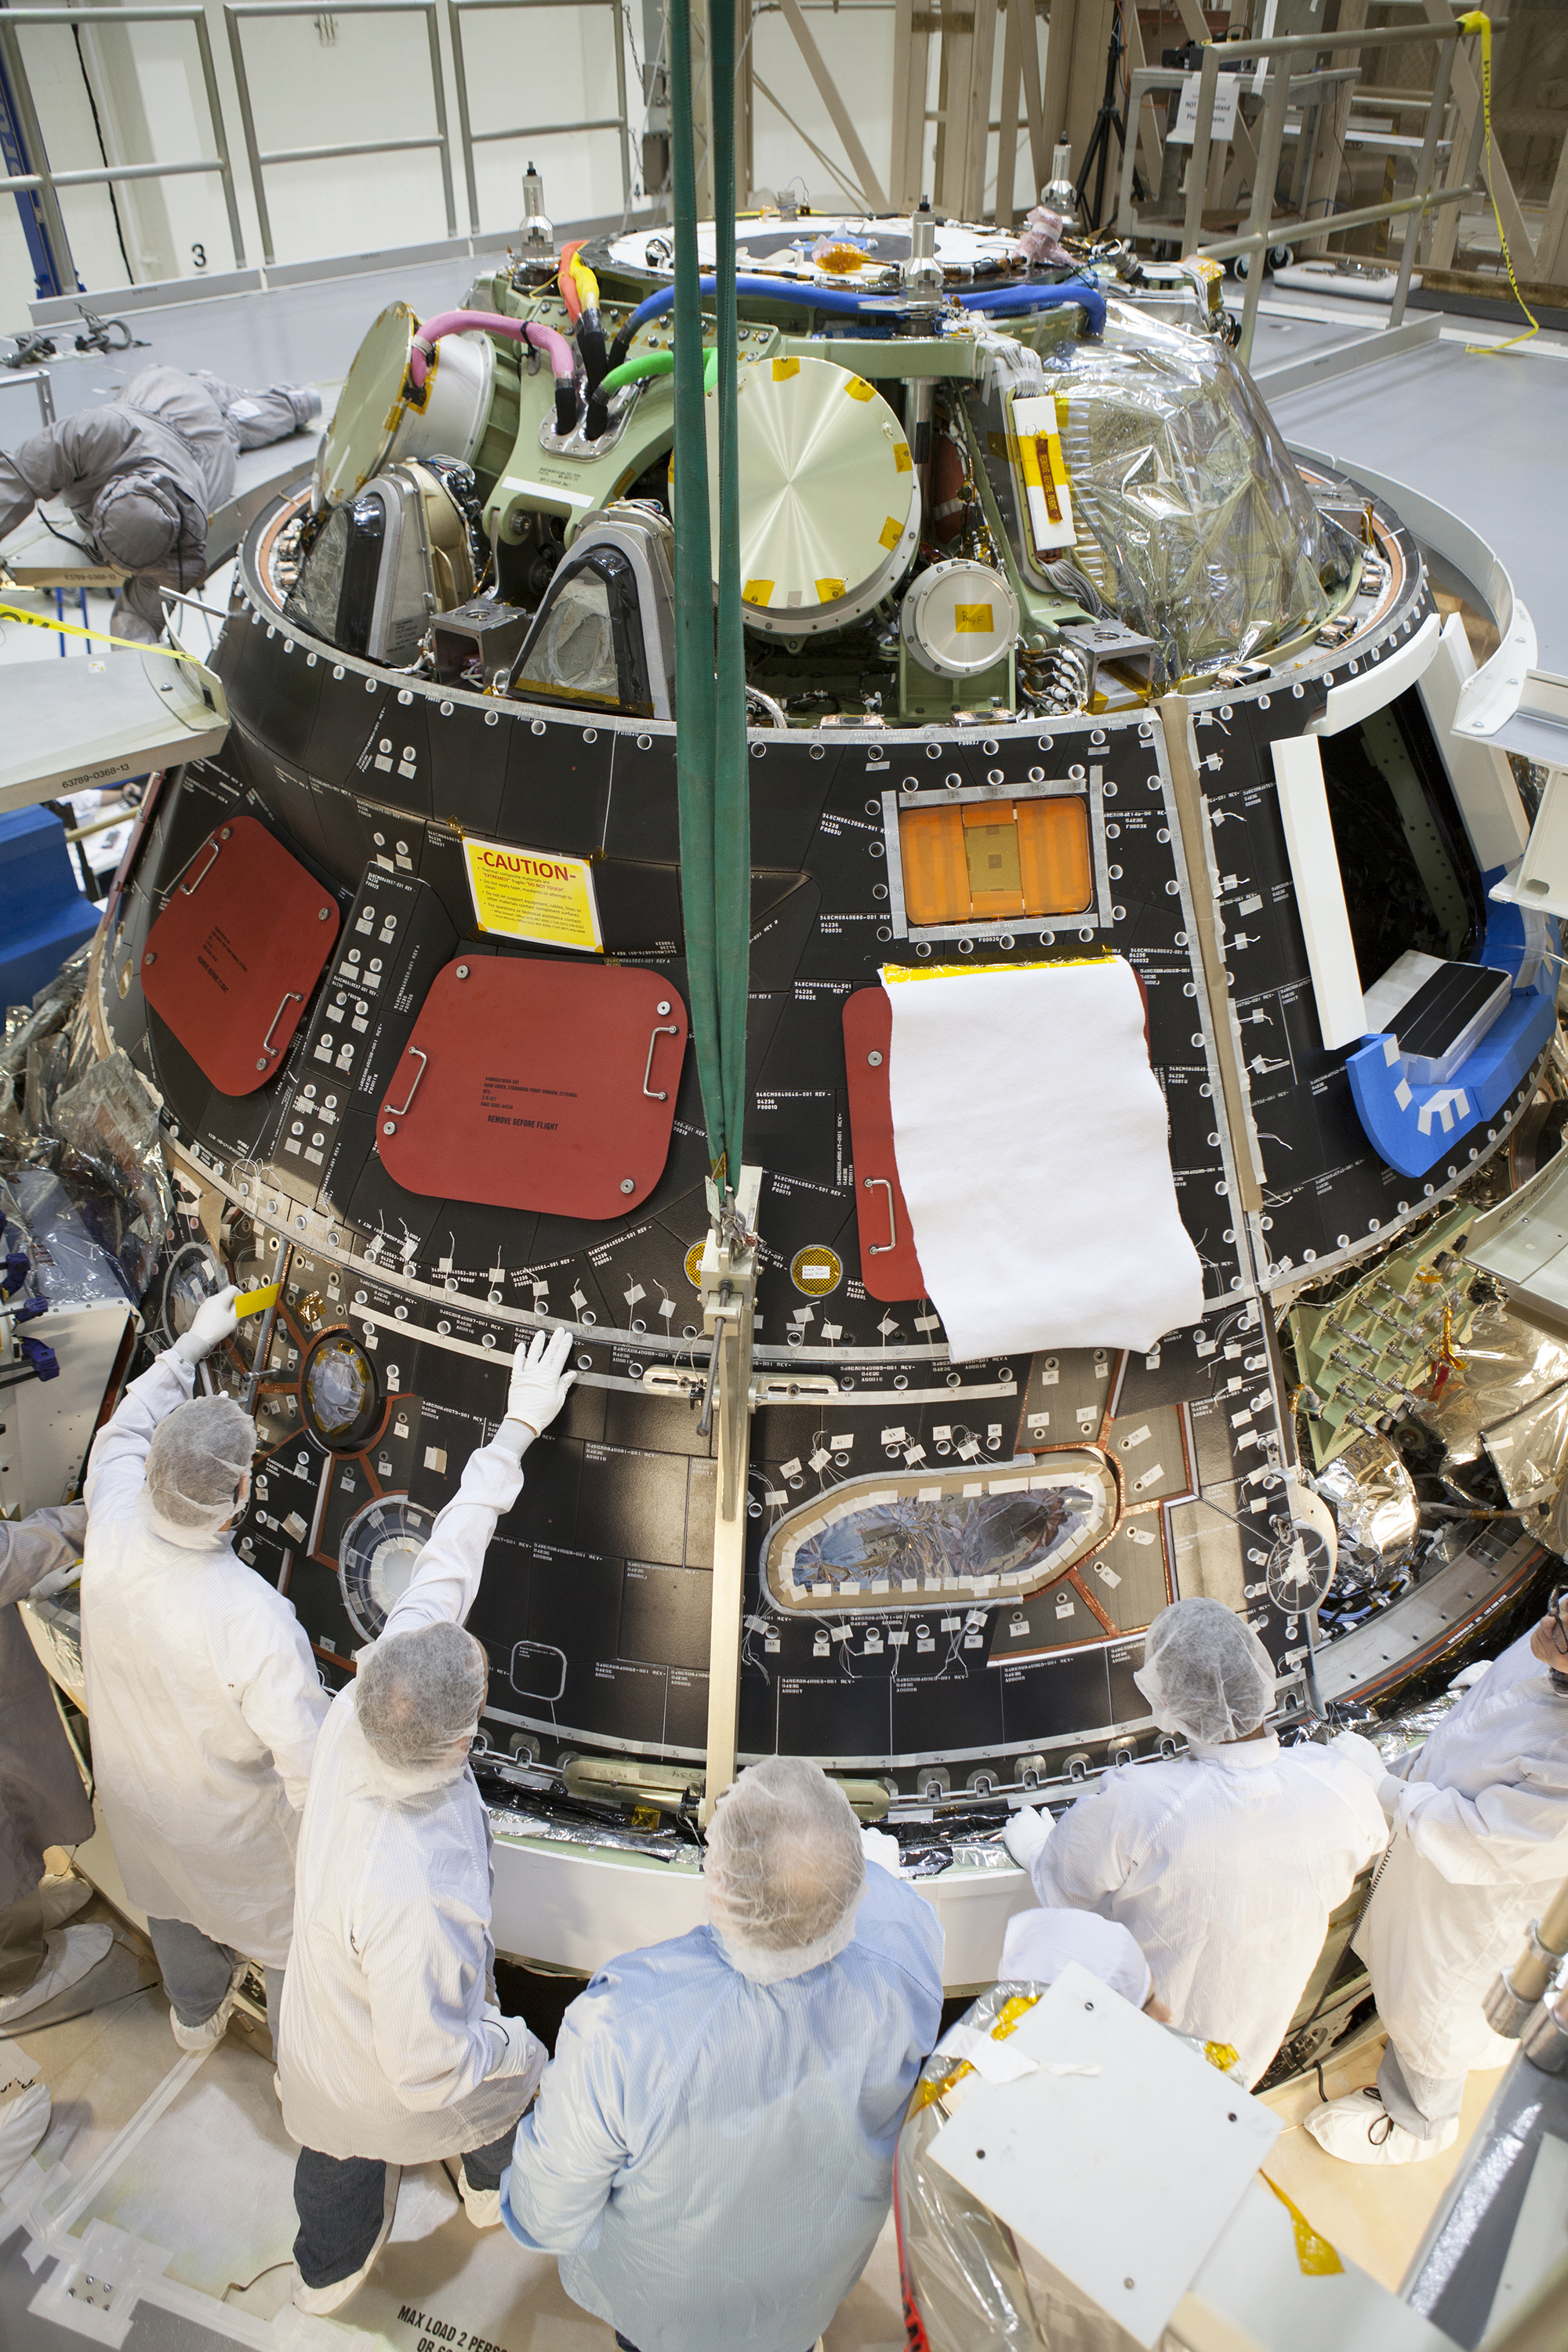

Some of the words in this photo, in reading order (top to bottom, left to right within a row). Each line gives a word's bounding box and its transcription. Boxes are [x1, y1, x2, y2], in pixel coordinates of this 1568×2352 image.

[191, 244, 207, 267] 3
[62, 764, 129, 788] 63789-0368-13
[1031, 785, 1045, 793] 130
[947, 792, 960, 802] 128
[821, 820, 839, 829] 04236
[822, 812, 878, 832] 948CM0842098-001
[820, 826, 842, 836] F0003U
[477, 851, 576, 882] -CAUTION-
[481, 866, 499, 875] Thermal
[499, 870, 521, 879] composite
[521, 874, 542, 883] materials
[521, 886, 542, 895] maskants
[890, 886, 902, 895] 138
[499, 898, 517, 906] materials
[535, 905, 560, 913] component
[524, 898, 549, 907] equipment,
[1040, 921, 1051, 930] 129
[916, 931, 929, 939] 133
[368, 975, 373, 985] 4
[399, 996, 408, 1011] 04236
[488, 1115, 511, 1124] REMOVE
[513, 1119, 535, 1128] BEFORE
[537, 1121, 558, 1131] FLIGHT
[773, 1181, 790, 1190] 04236
[774, 1174, 829, 1193] 948CM0840587-501
[771, 1187, 791, 1196] F00019
[592, 1252, 608, 1262] 04236
[397, 2304, 426, 2328] MAX
[425, 2318, 456, 2342] LOAD
[457, 2332, 467, 2347] 2
